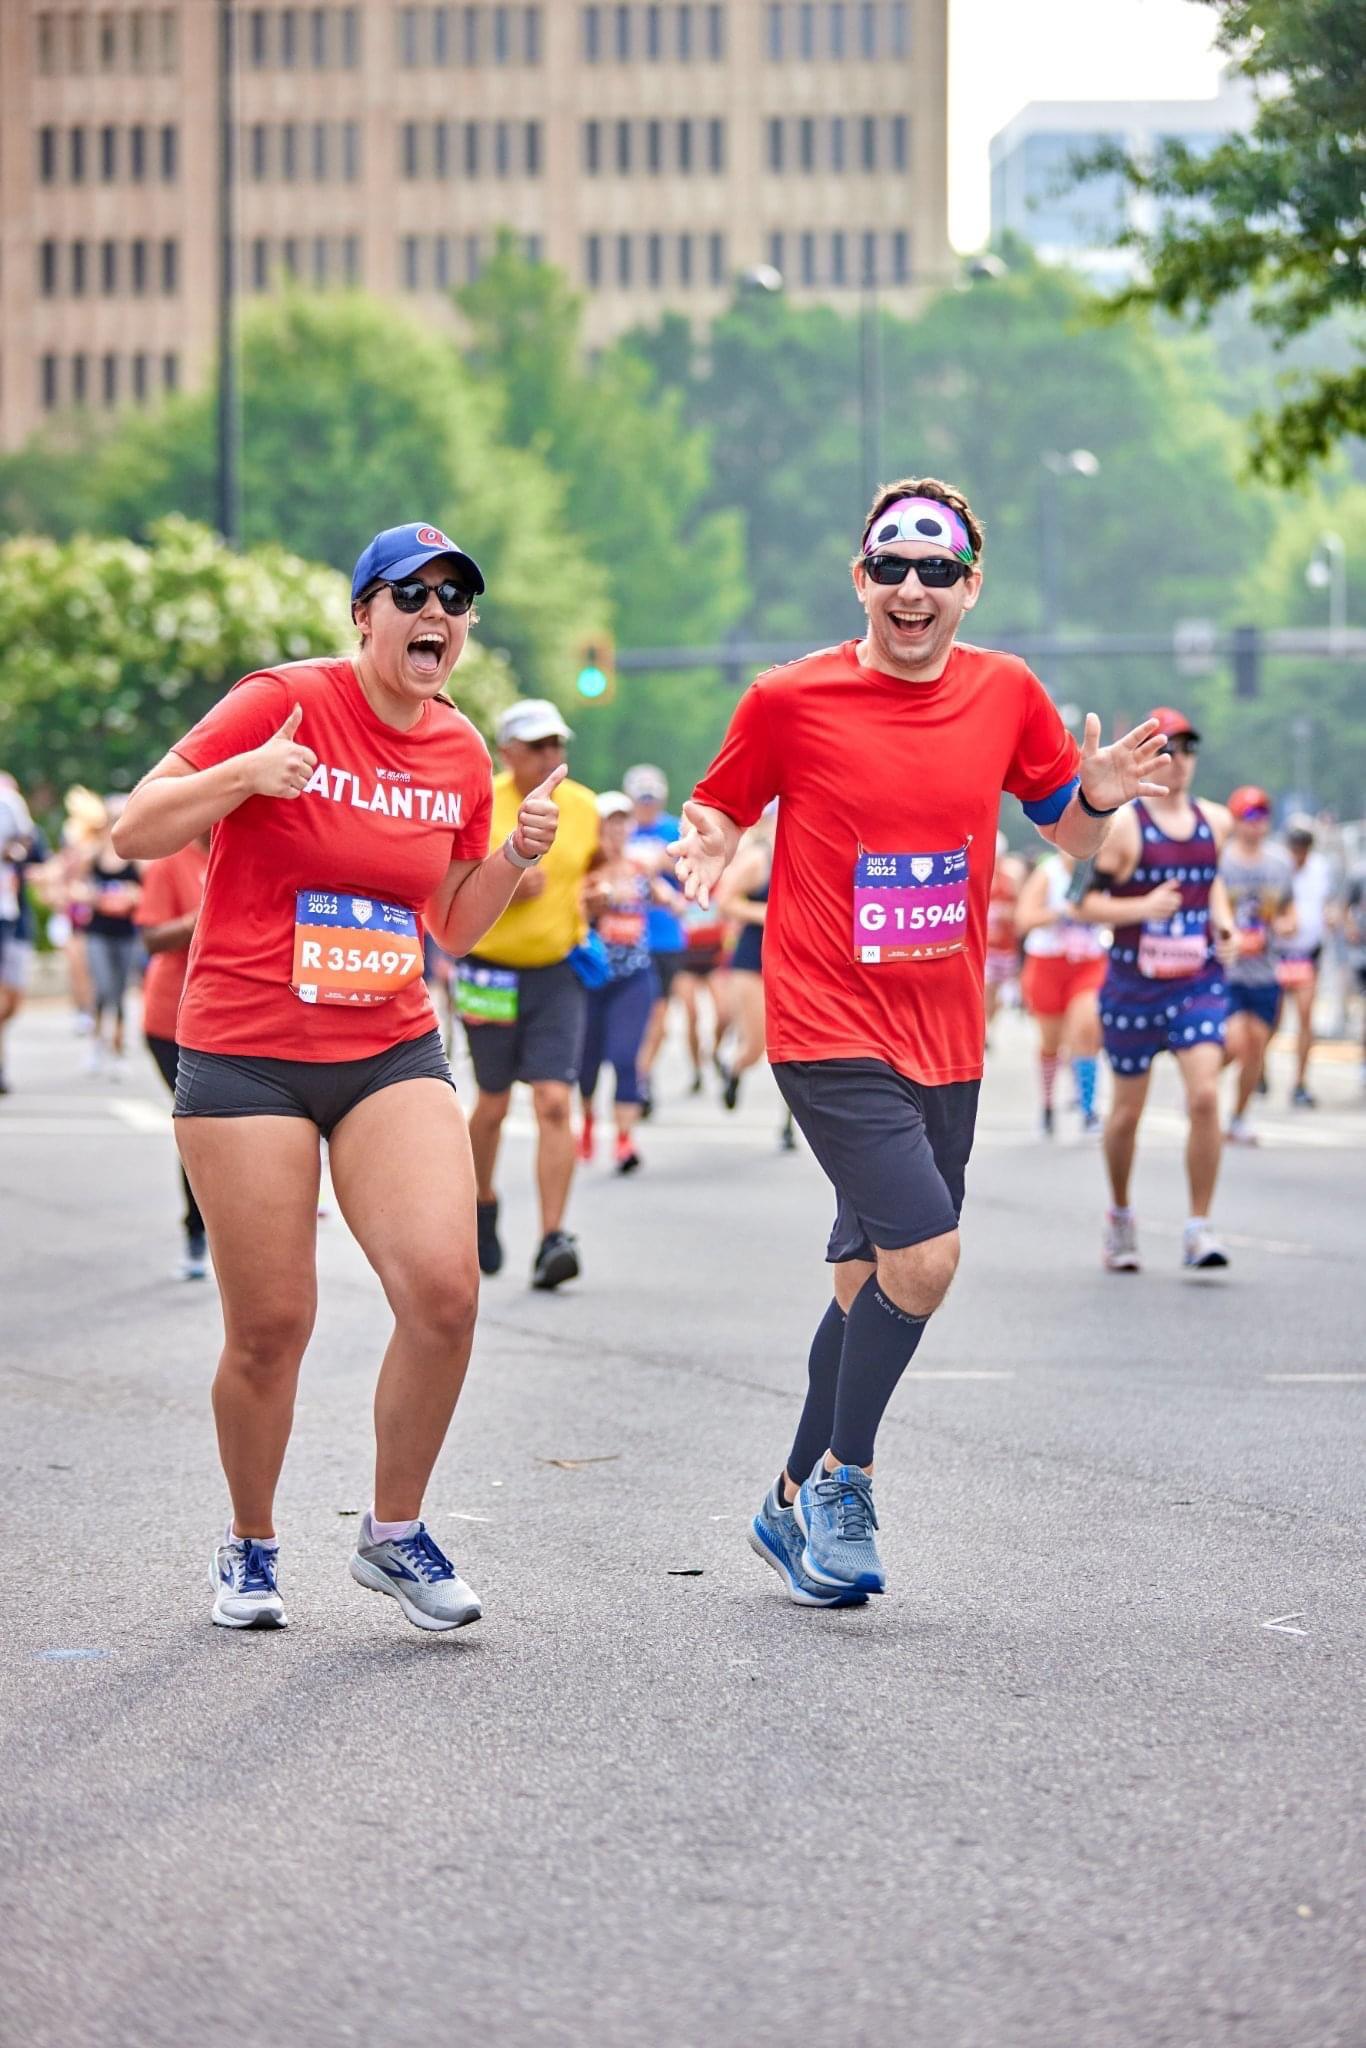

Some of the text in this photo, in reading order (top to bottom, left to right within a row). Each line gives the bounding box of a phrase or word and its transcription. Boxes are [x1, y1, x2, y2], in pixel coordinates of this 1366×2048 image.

[302, 763, 462, 825] ATLANTAN
[867, 857, 897, 866] JULY 4
[866, 866, 897, 876] 2022
[308, 894, 338, 904] JULY 4
[308, 902, 338, 915] 2022
[859, 900, 967, 931] G 15946
[301, 940, 417, 976] R 35497
[874, 1291, 896, 1315] RUN
